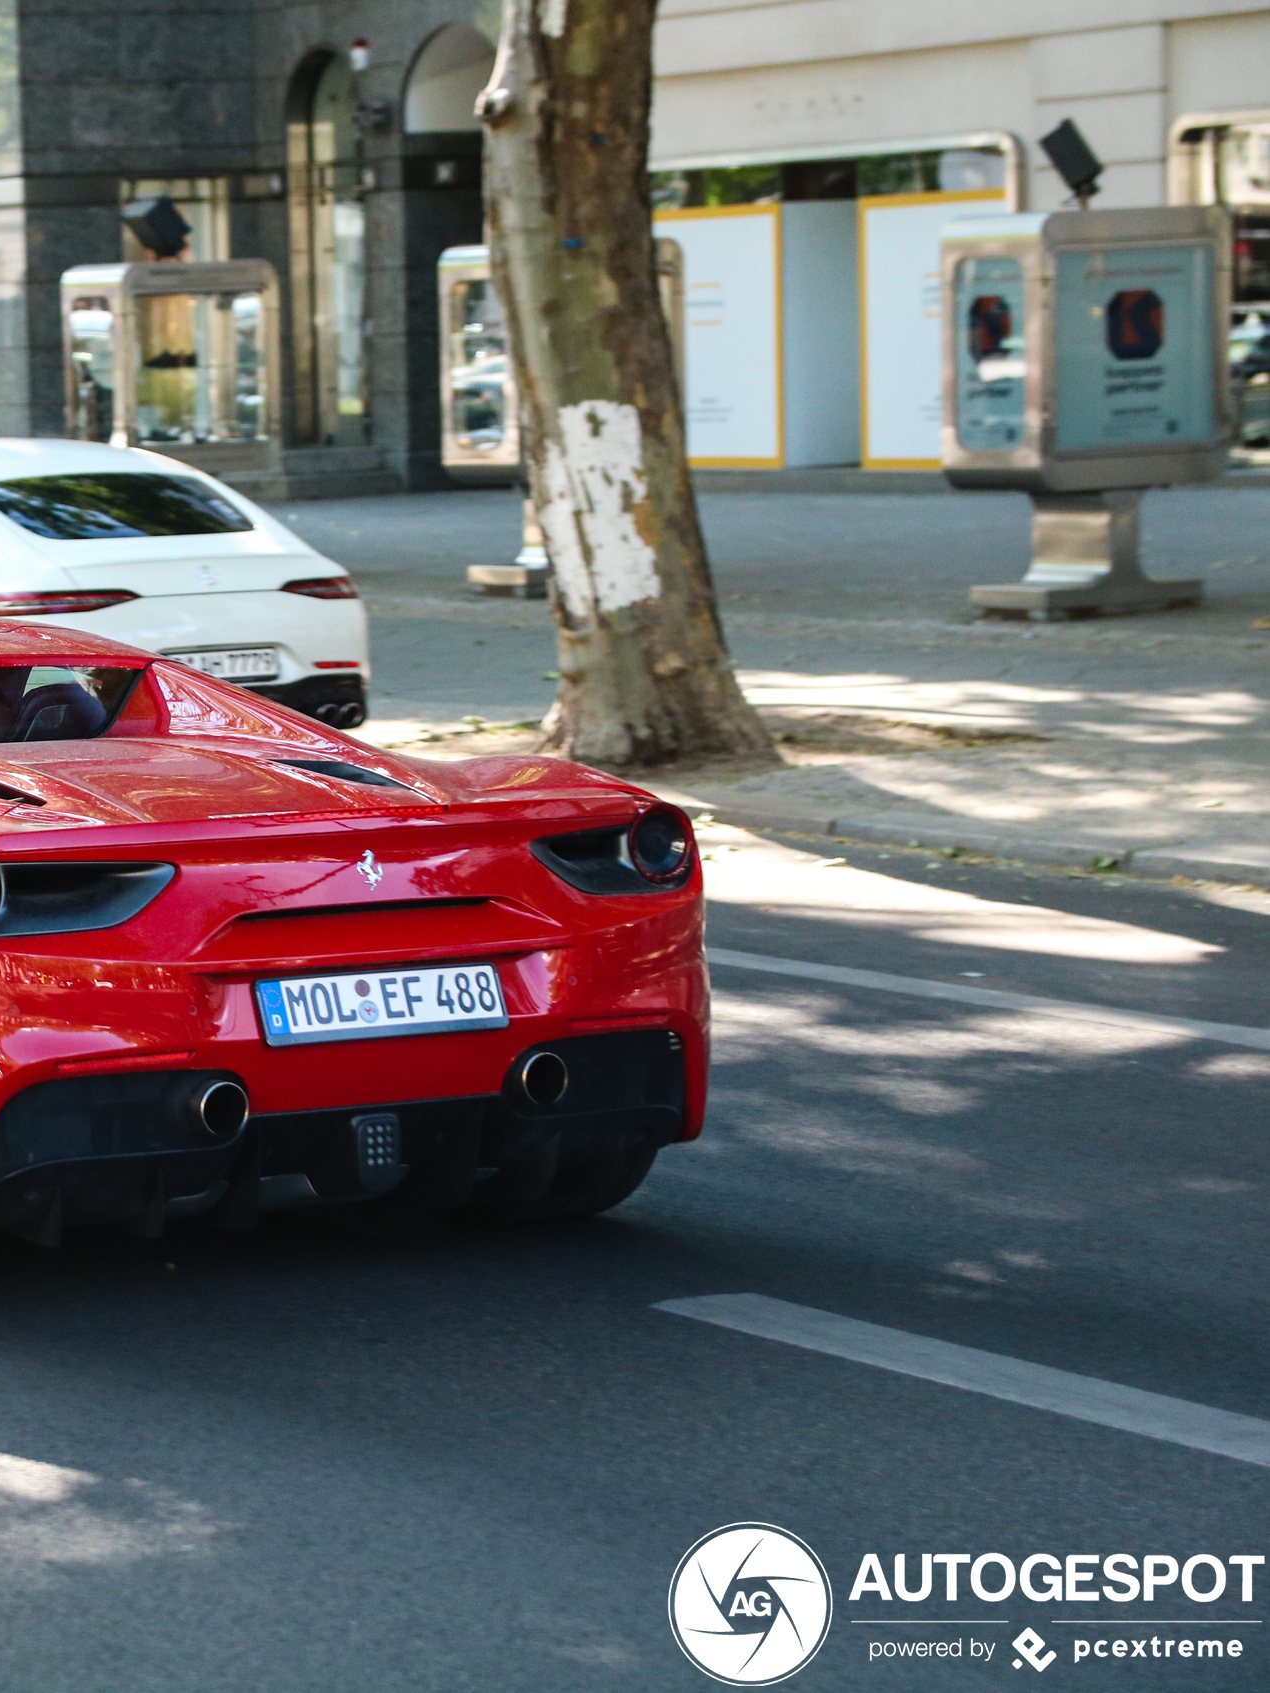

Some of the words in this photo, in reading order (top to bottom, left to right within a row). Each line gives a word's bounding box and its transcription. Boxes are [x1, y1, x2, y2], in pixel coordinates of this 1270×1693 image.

[271, 1013, 282, 1027] D
[284, 982, 357, 1028] MOL
[379, 976, 423, 1019] EF
[436, 971, 497, 1014] 488
